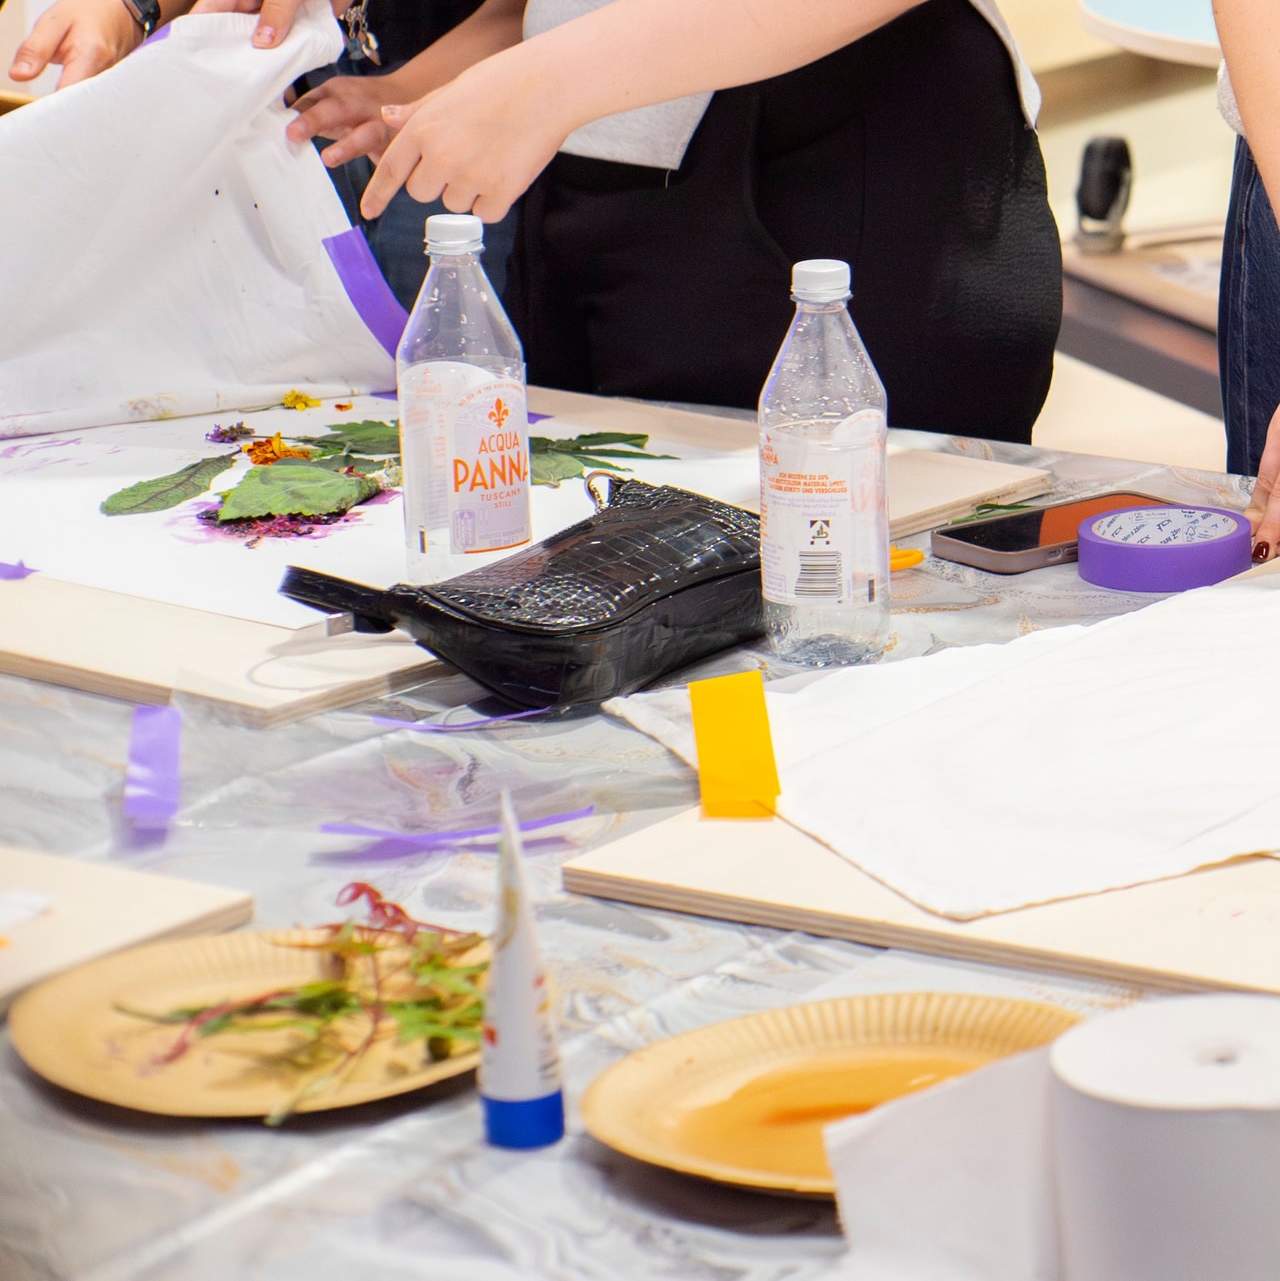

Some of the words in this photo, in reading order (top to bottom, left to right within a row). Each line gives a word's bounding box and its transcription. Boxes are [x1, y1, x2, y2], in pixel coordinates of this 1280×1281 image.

[479, 431, 520, 454] ACQUA
[480, 488, 521, 502] TUSCANY
[494, 501, 512, 509] STILL
